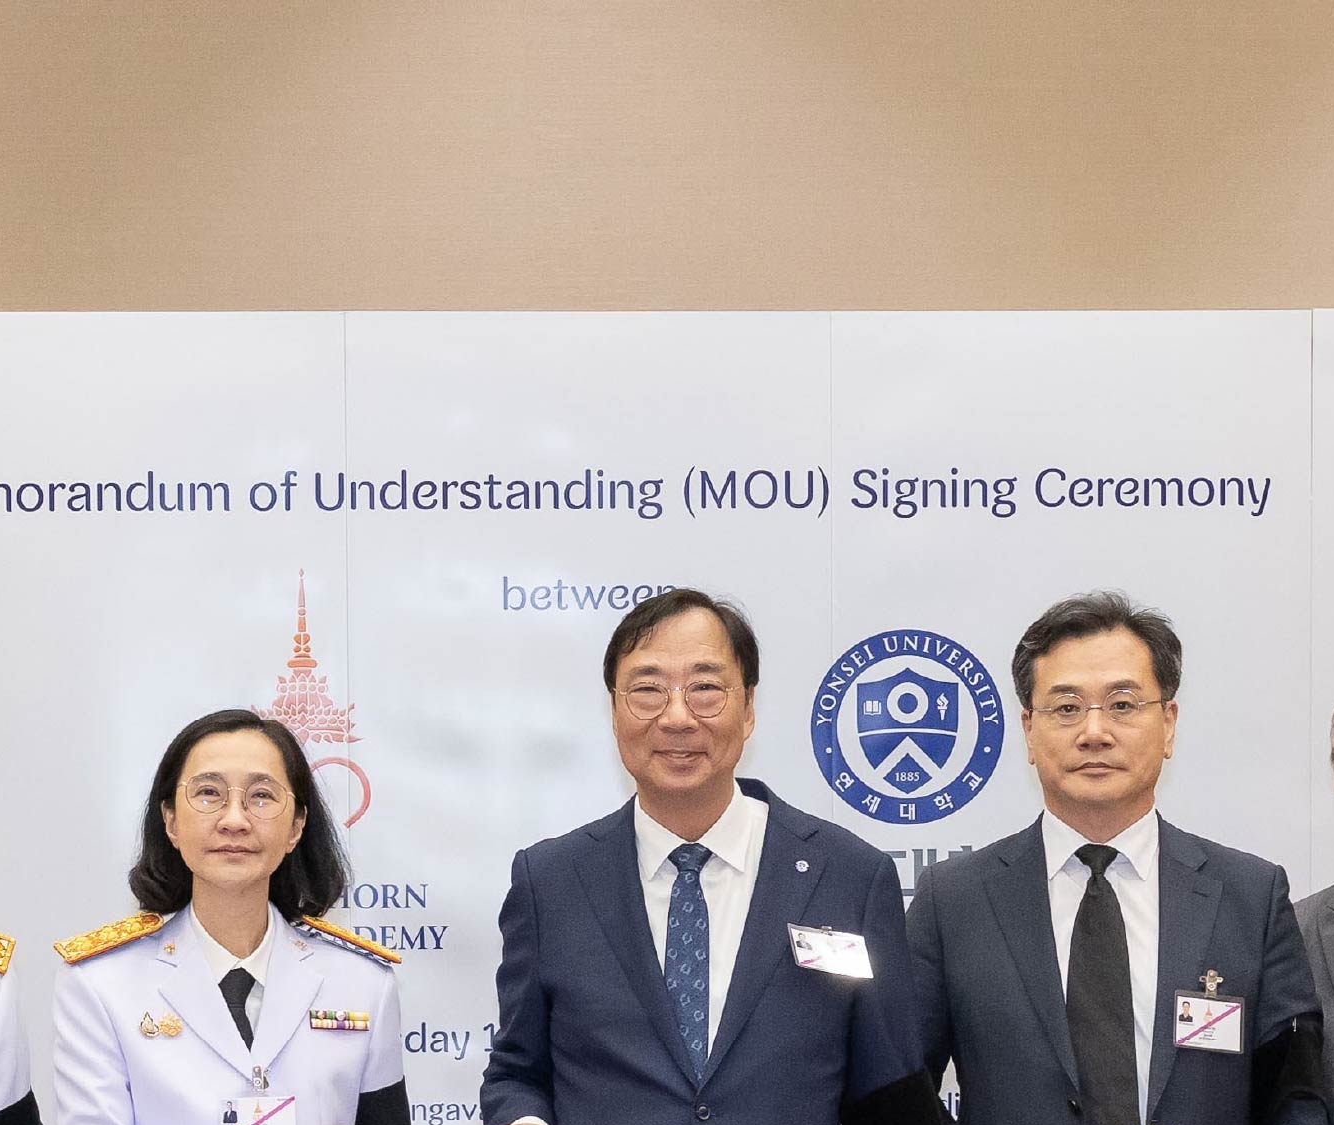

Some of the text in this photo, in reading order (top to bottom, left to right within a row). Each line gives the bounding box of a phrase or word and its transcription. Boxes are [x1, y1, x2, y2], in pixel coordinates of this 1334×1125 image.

[249, 470, 298, 512] of
[314, 468, 664, 520] Understanding
[683, 465, 830, 519] (MOU)
[850, 467, 1018, 519] Signing
[1034, 467, 1271, 517] Ceremony
[816, 635, 999, 727] YONSEI UNIVERSITY
[834, 771, 984, 821] 연세대학교
[894, 772, 921, 782] 1885
